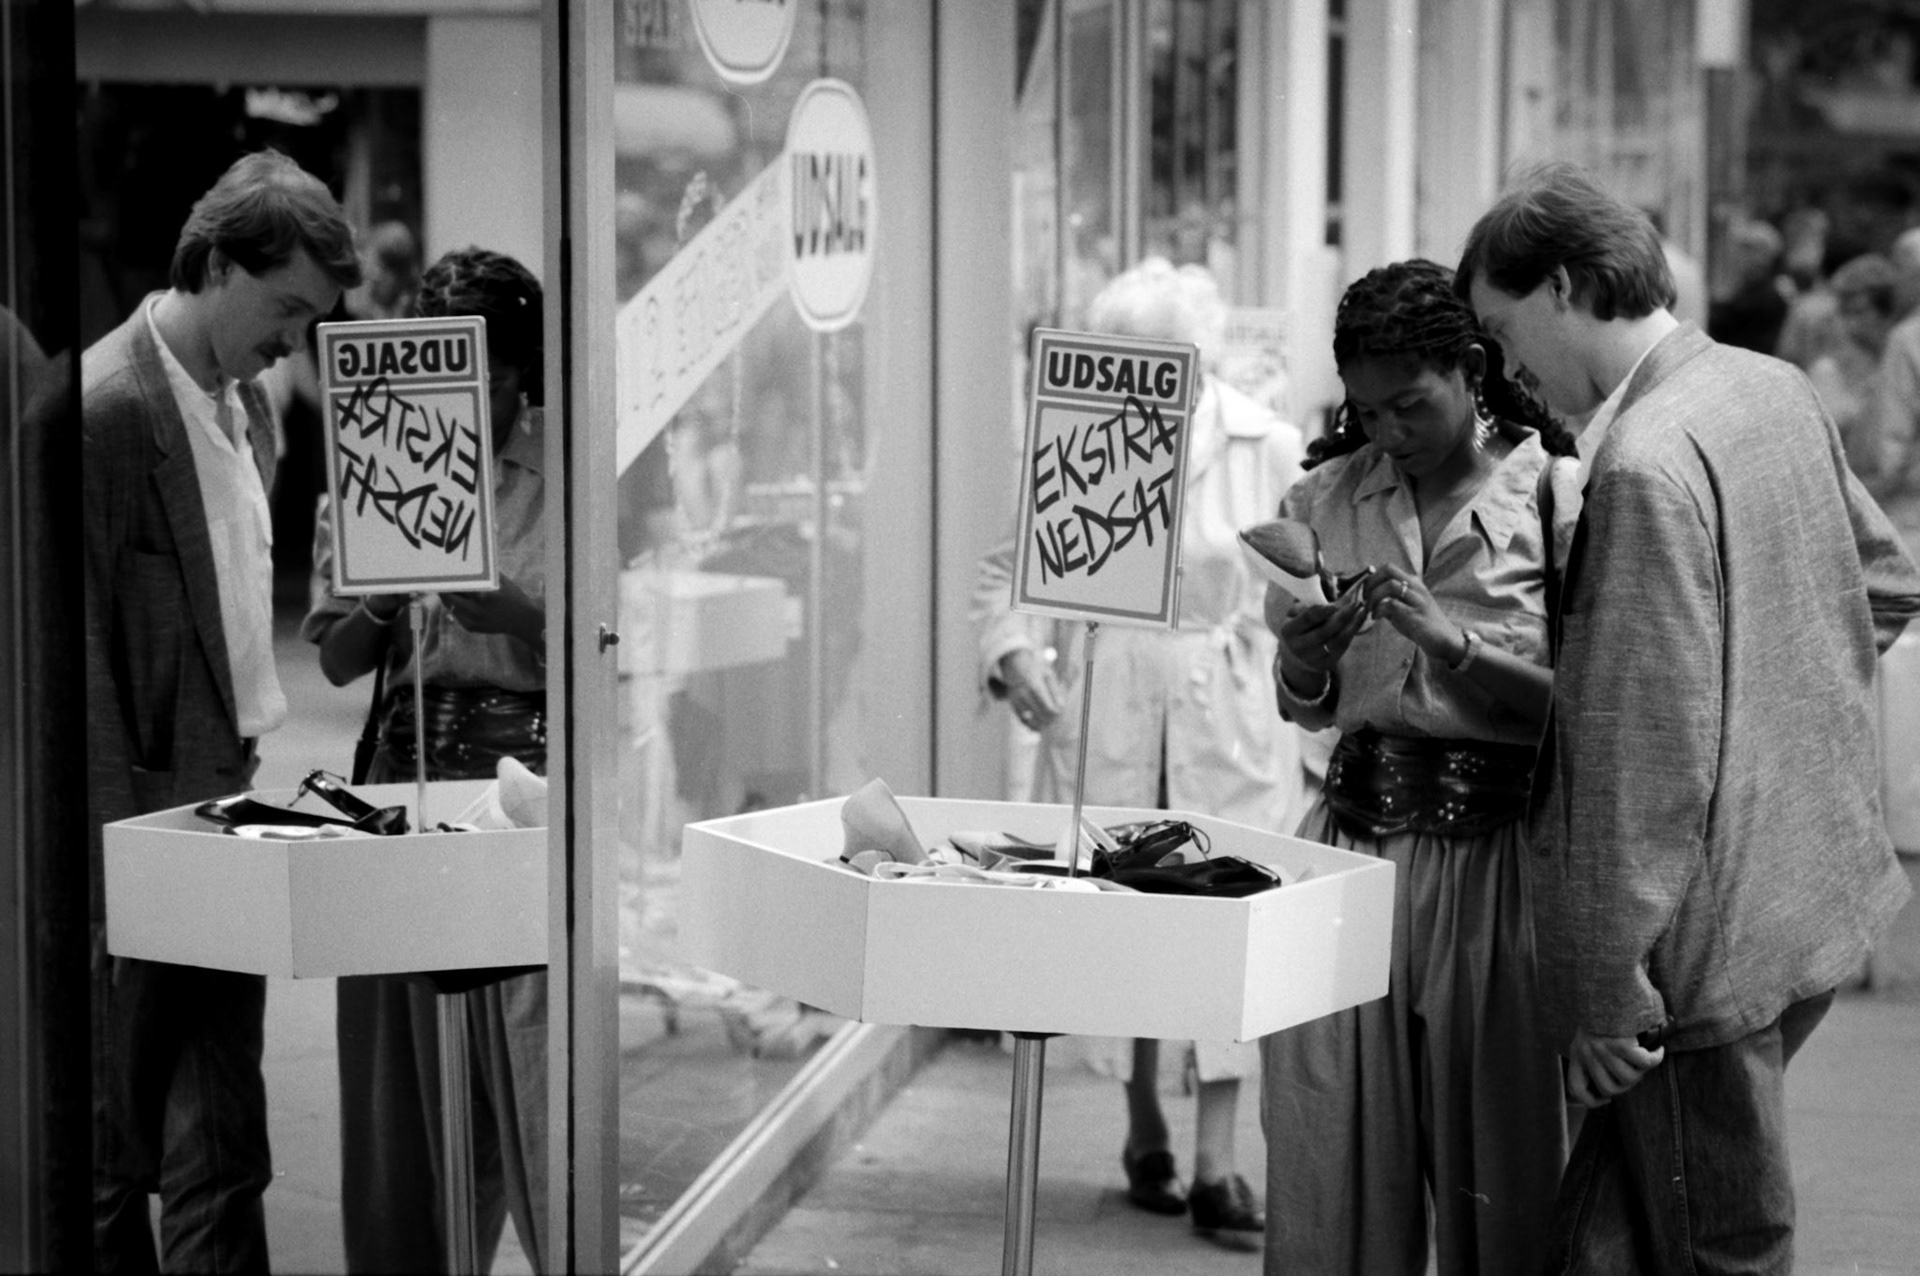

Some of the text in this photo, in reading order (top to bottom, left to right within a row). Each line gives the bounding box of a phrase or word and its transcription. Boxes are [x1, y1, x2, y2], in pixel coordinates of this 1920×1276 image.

[1047, 351, 1178, 400] UDSALG
[1032, 394, 1179, 514] EKSTRA
[1034, 468, 1176, 586] NEDSAT
